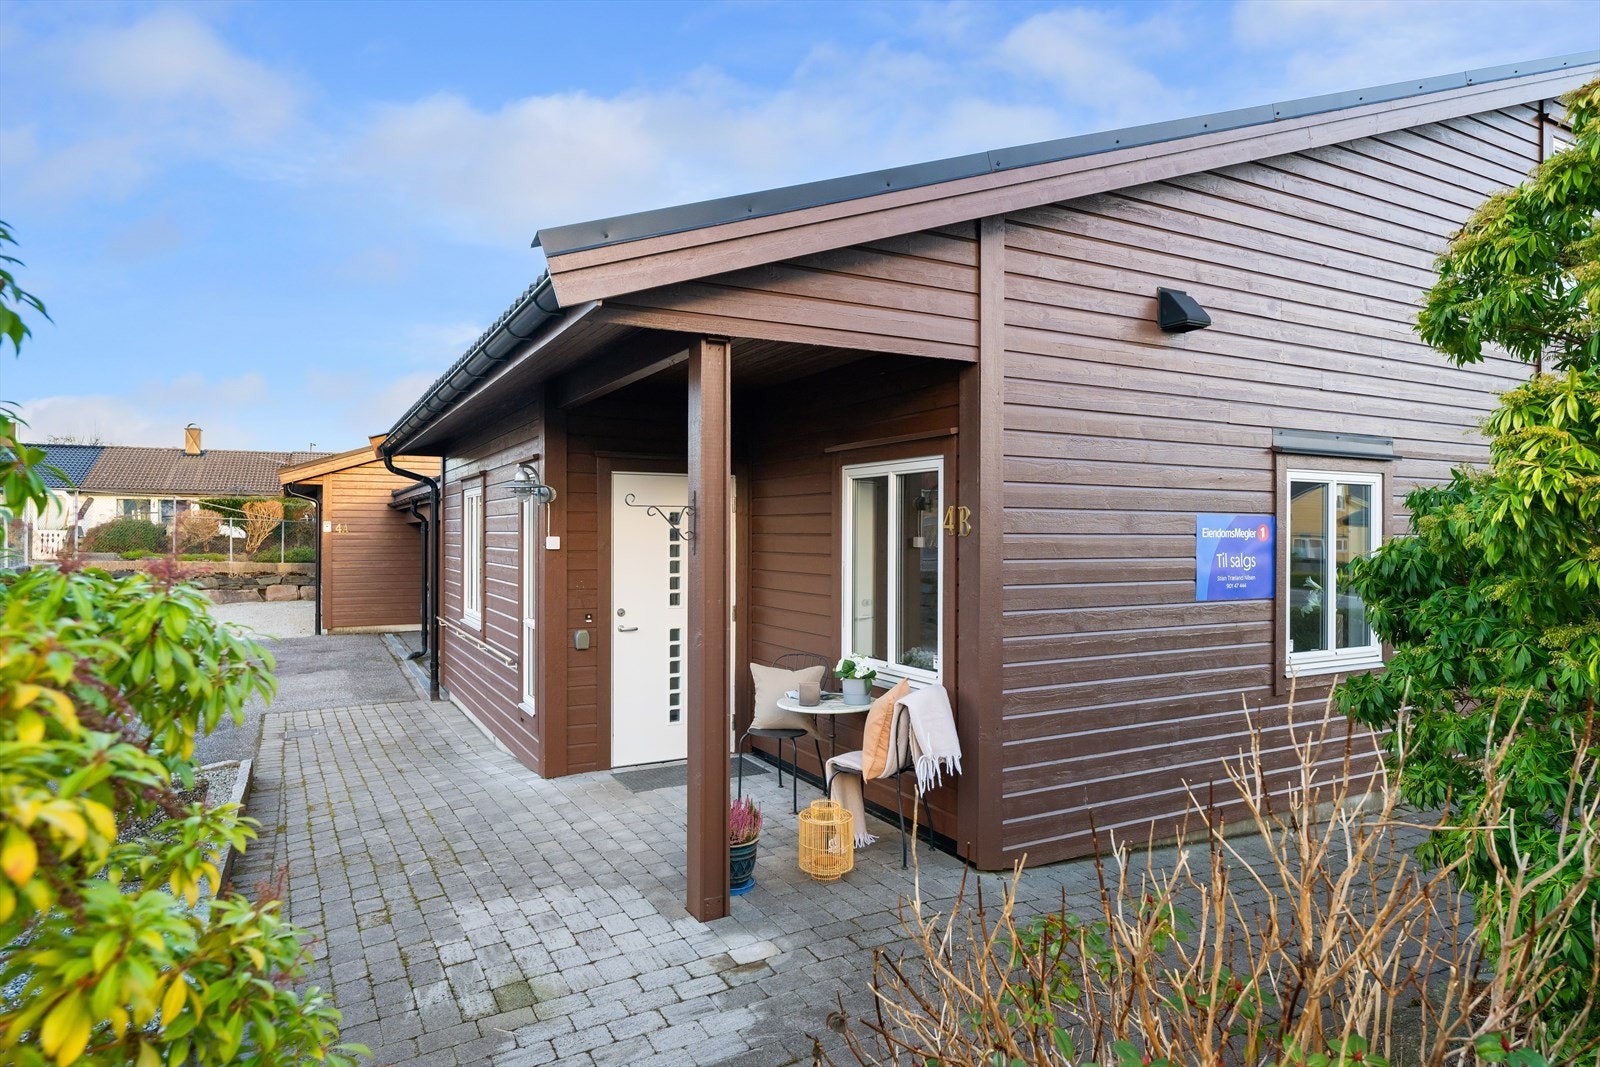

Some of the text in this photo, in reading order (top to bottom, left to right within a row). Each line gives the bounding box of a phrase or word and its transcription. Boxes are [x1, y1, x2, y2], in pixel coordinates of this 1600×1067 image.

[943, 505, 971, 537] 4B
[1202, 527, 1256, 540] EiendomsMegler
[1216, 552, 1256, 571] Til salgs
